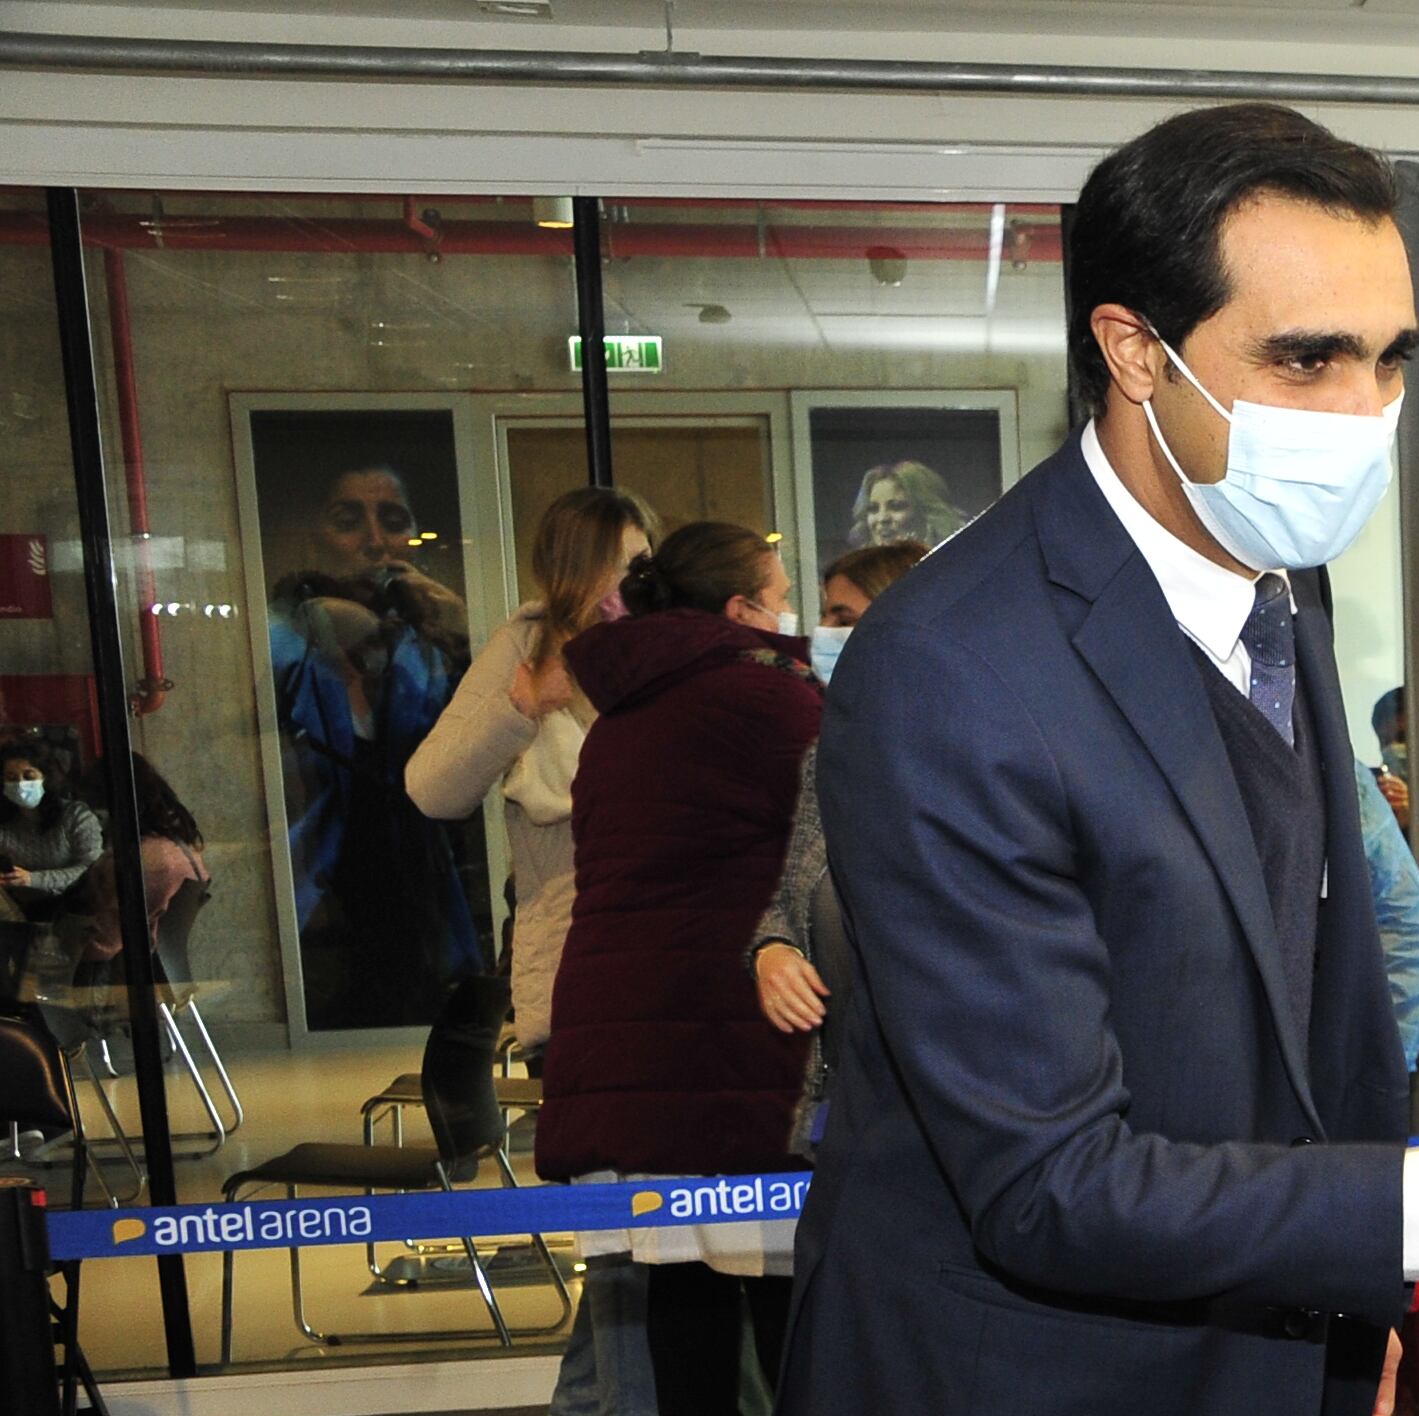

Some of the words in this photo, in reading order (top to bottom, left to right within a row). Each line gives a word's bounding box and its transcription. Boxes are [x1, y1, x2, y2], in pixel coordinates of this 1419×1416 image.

[669, 1177, 764, 1218] antel
[769, 1181, 811, 1212] ar
[153, 1206, 254, 1246] antel
[260, 1206, 372, 1239] arena
